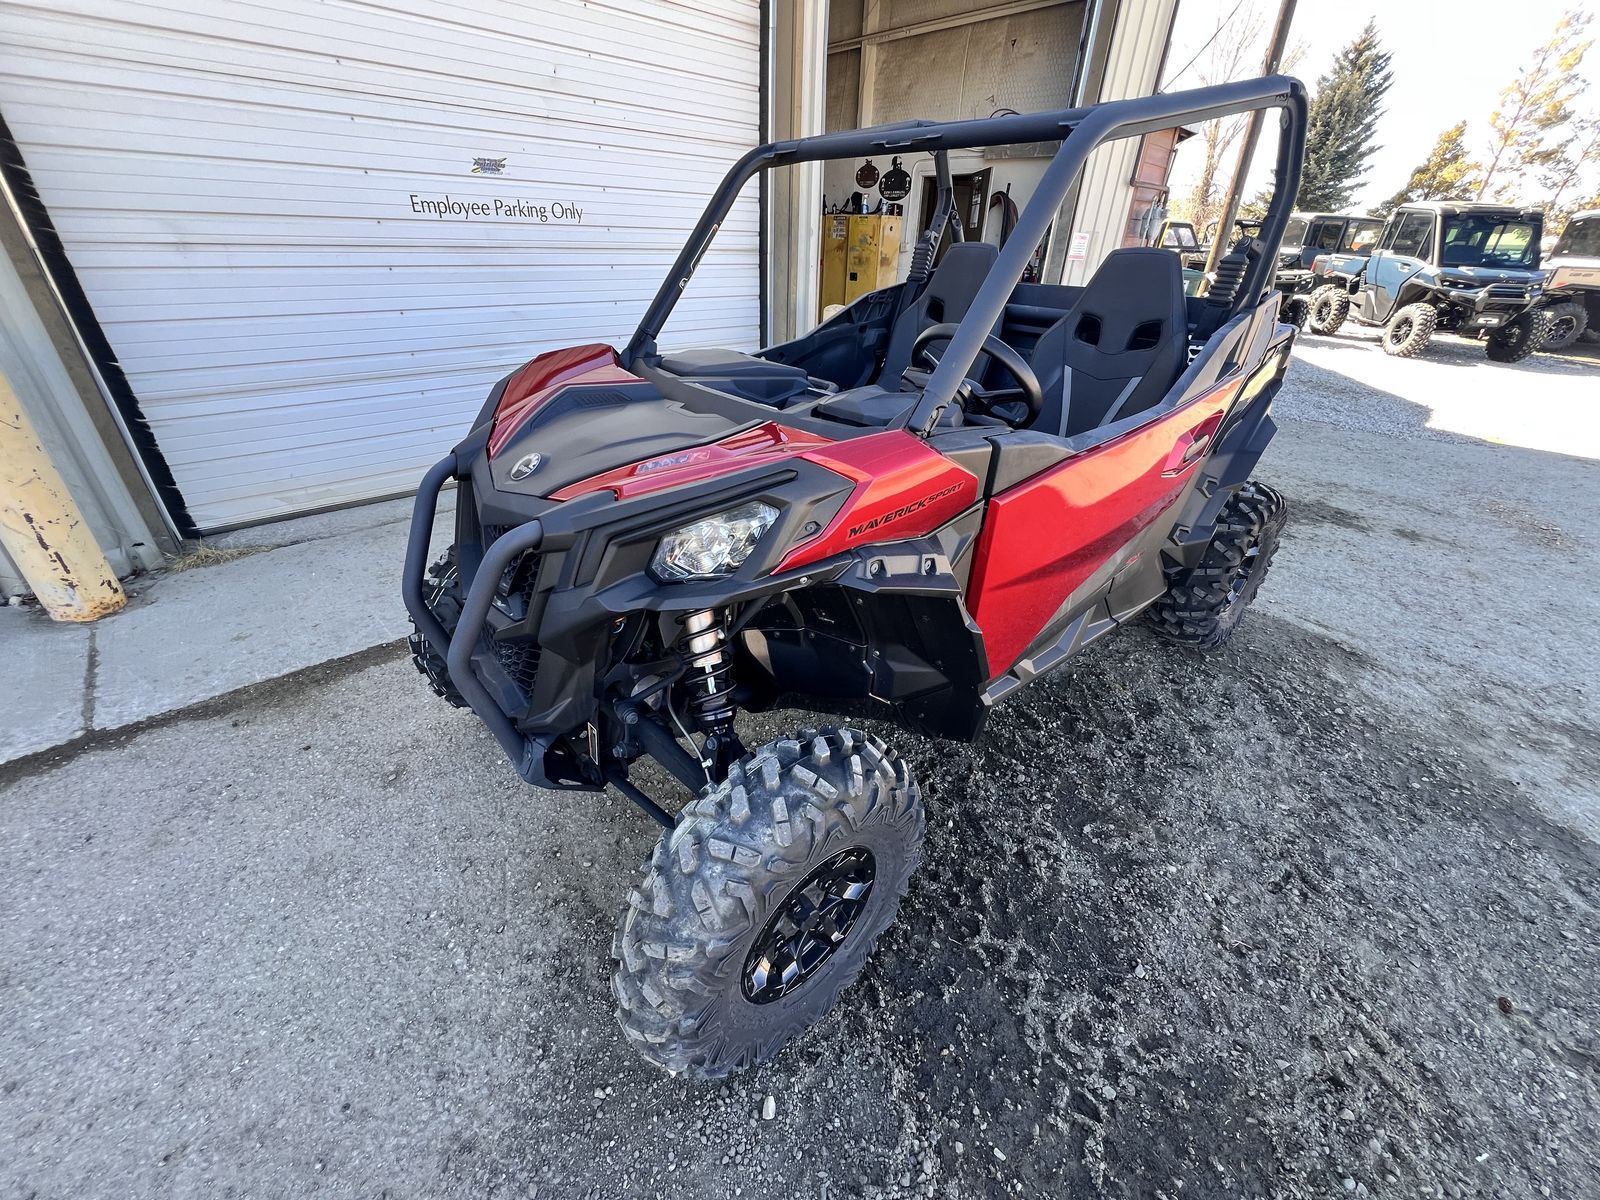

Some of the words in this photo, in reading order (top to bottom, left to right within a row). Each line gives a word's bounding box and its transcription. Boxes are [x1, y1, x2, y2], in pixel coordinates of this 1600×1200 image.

[410, 194, 490, 219] Employee
[494, 199, 548, 222] Parking
[551, 202, 583, 223] Only
[848, 497, 928, 538] MAVERICK
[927, 483, 963, 503] SPORT
